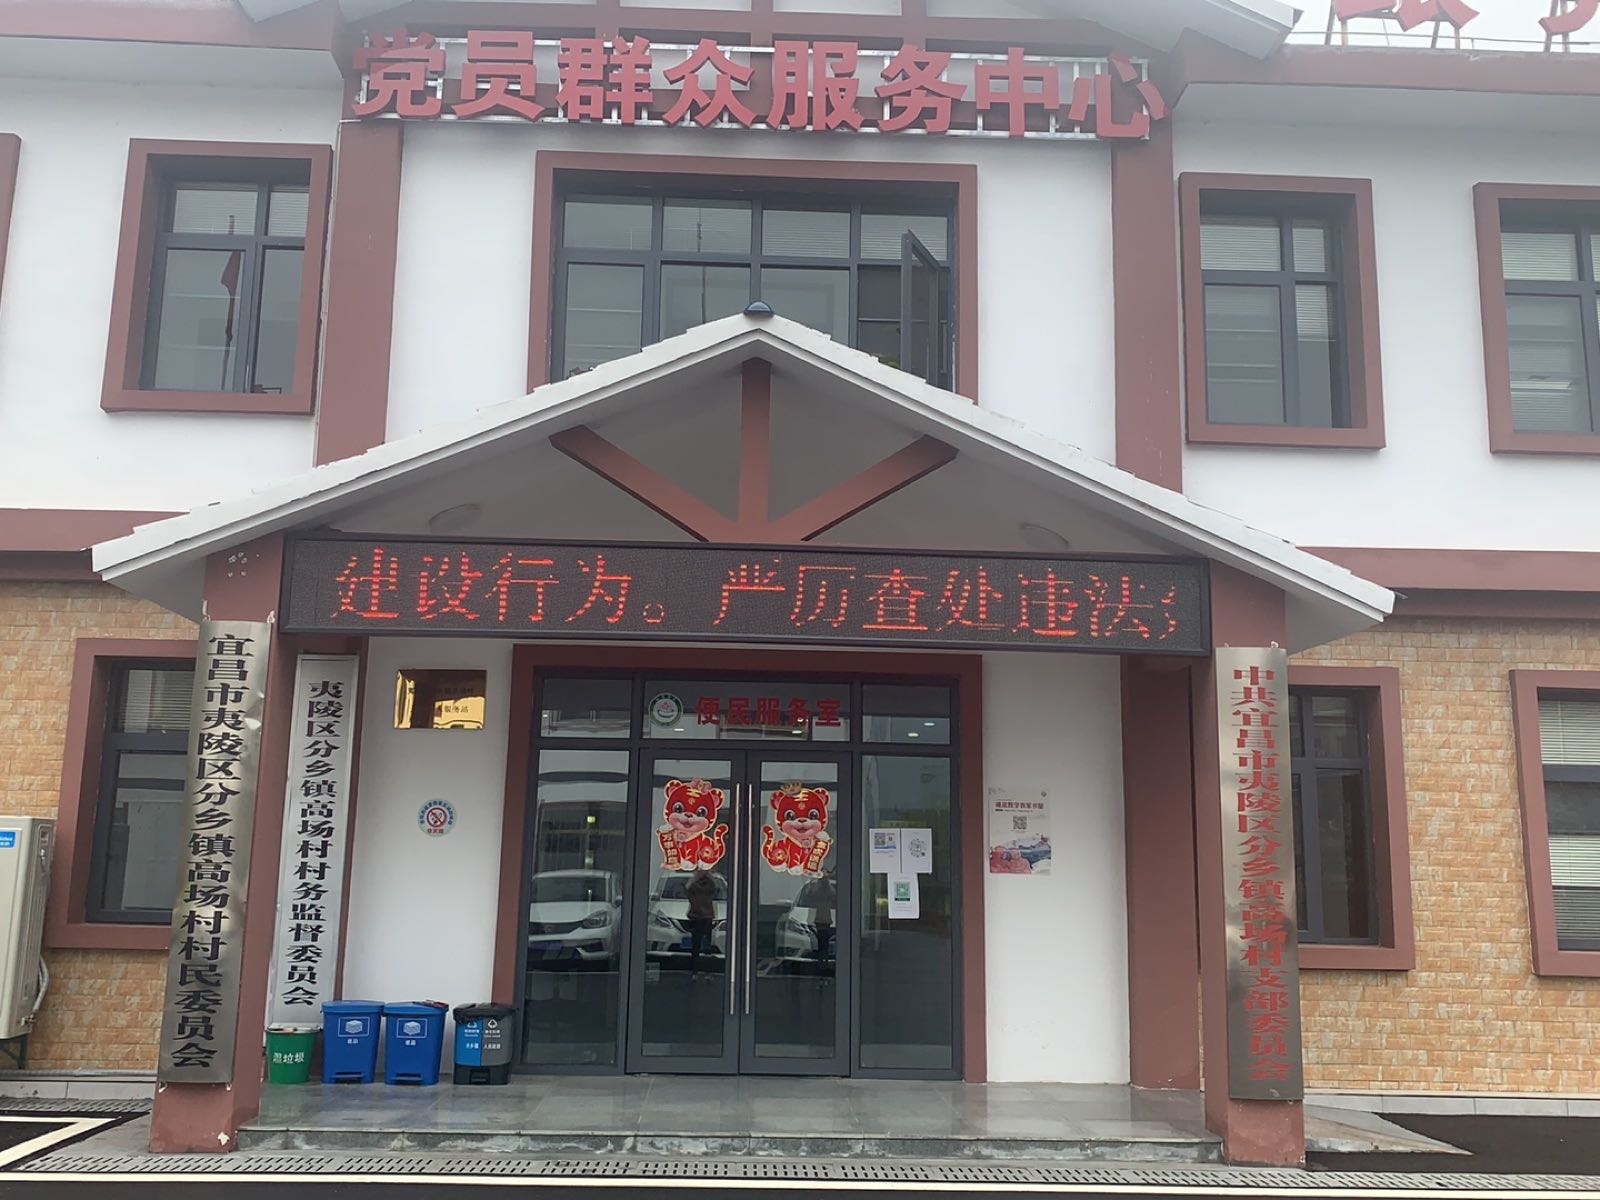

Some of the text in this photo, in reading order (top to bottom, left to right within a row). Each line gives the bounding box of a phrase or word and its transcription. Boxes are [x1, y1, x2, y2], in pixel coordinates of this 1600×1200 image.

[352, 29, 1167, 141] 党员群众服务中心
[330, 546, 1178, 640] 建设行为。严厉查处违法
[695, 696, 841, 726] 便民服务室
[171, 634, 255, 1068] 宜昌市夷陵区分乡镇高场村村民委员会
[281, 680, 345, 1006] 夷陵区分乡镇高场村村务监督委员会
[1231, 666, 1295, 1081] 中共宜昌市夷陵区分乡镇高场村支部委员会
